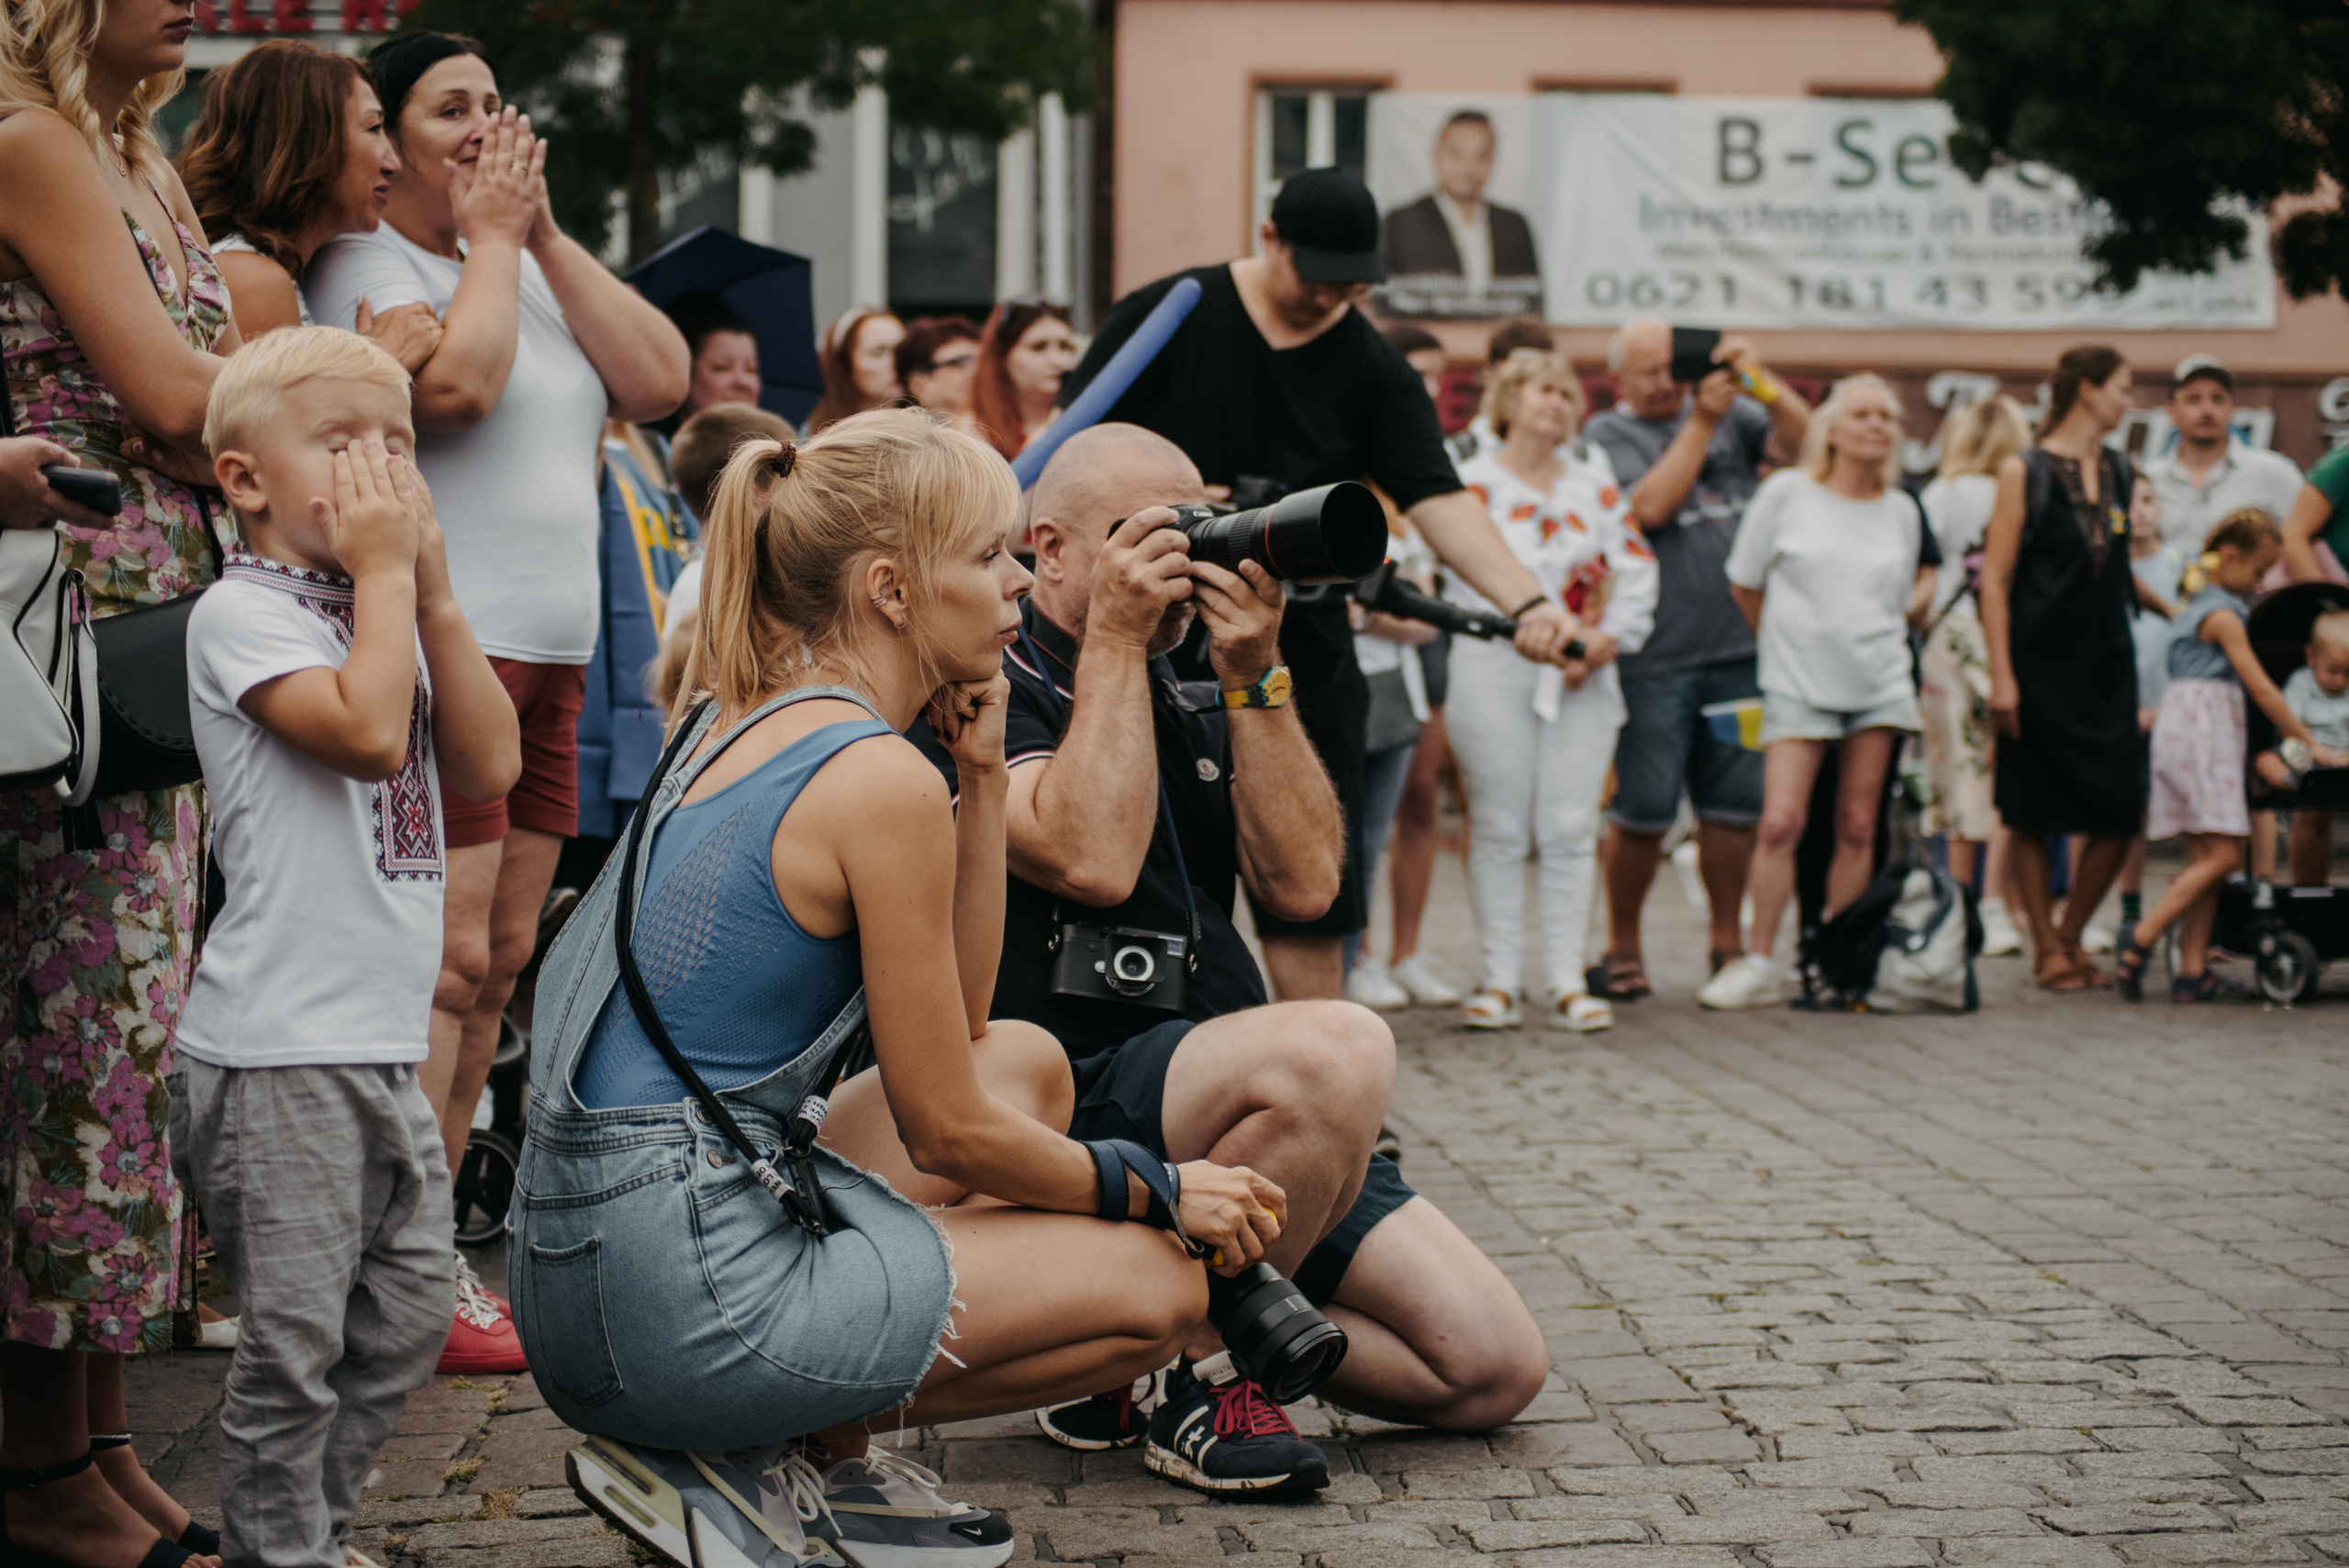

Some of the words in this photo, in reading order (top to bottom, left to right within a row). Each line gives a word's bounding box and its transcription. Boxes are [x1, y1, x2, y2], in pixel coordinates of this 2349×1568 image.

[1930, 195, 1972, 235] in
[1586, 272, 1736, 308] 0621
[1916, 274, 1987, 313] 43
[1053, 1432, 1071, 1444] 483
